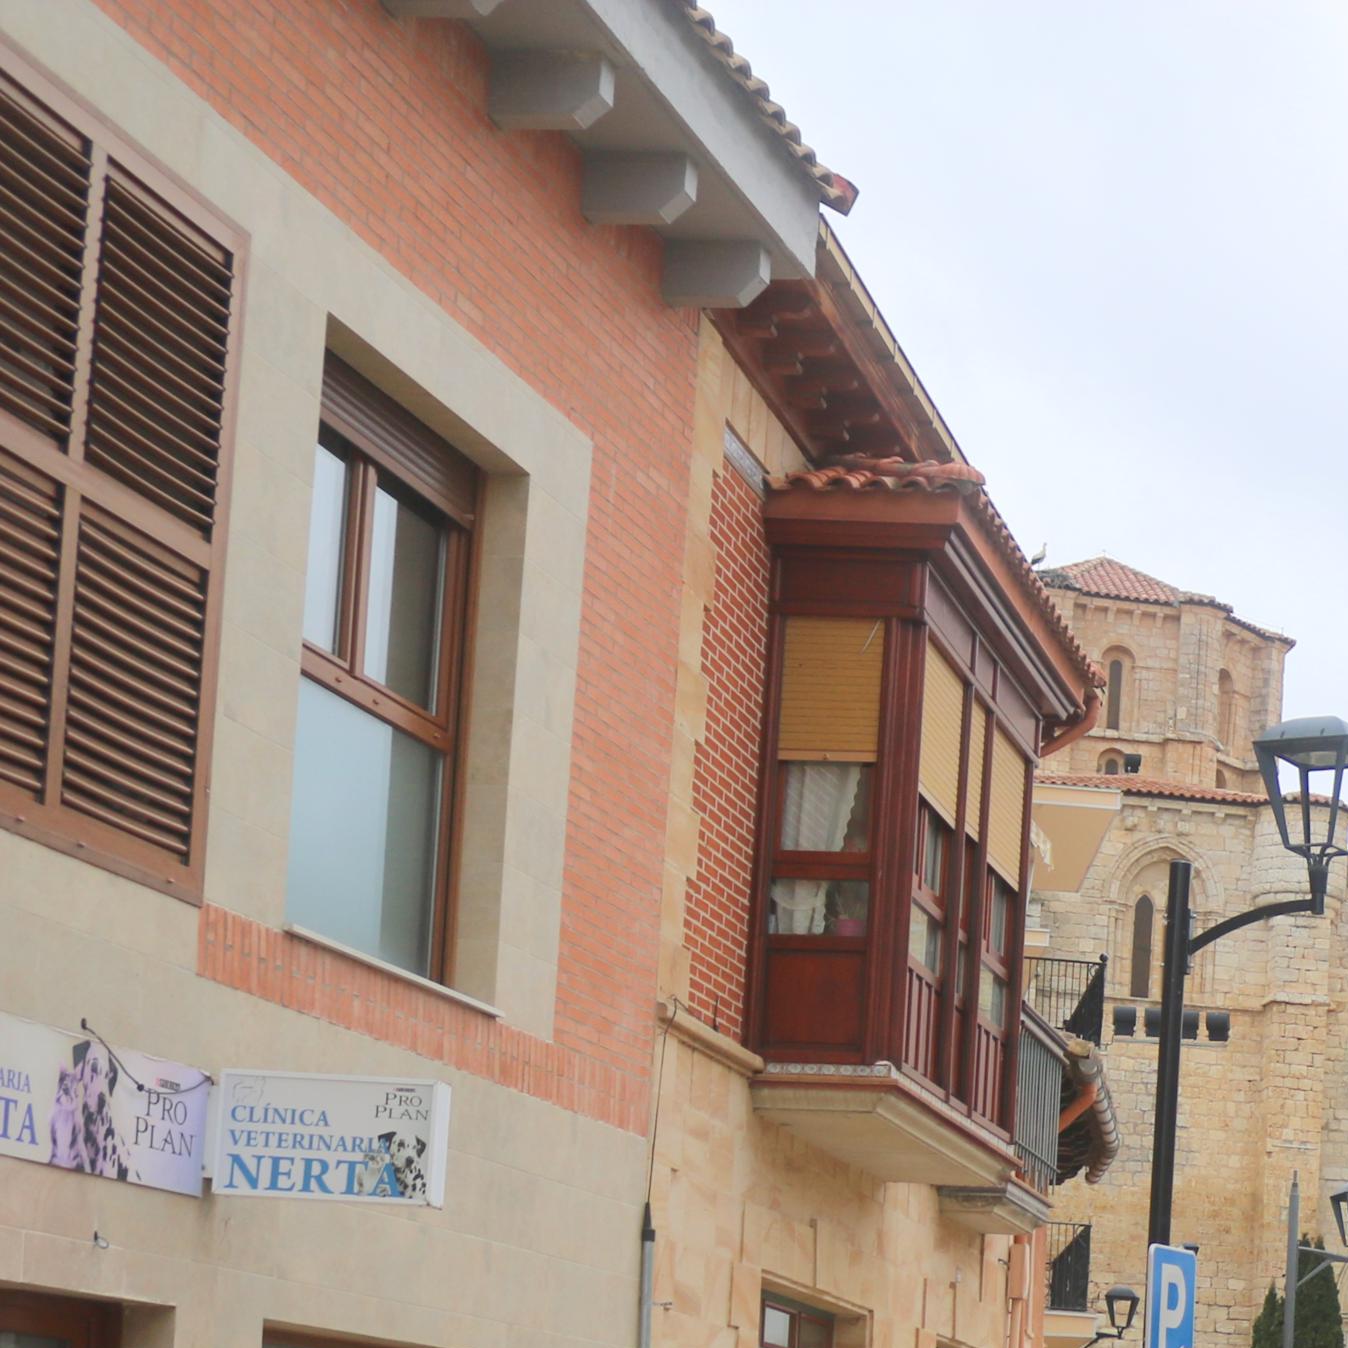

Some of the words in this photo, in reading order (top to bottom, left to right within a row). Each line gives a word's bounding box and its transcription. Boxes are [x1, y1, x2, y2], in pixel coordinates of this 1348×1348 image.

[145, 1088, 187, 1126] PRO
[385, 1092, 423, 1108] PRO
[231, 1103, 330, 1127] CLÍNICA
[374, 1105, 430, 1121] PLAN
[133, 1116, 196, 1158] PLAN
[229, 1129, 391, 1154] VETERINARIA
[223, 1153, 405, 1198] NERTA
